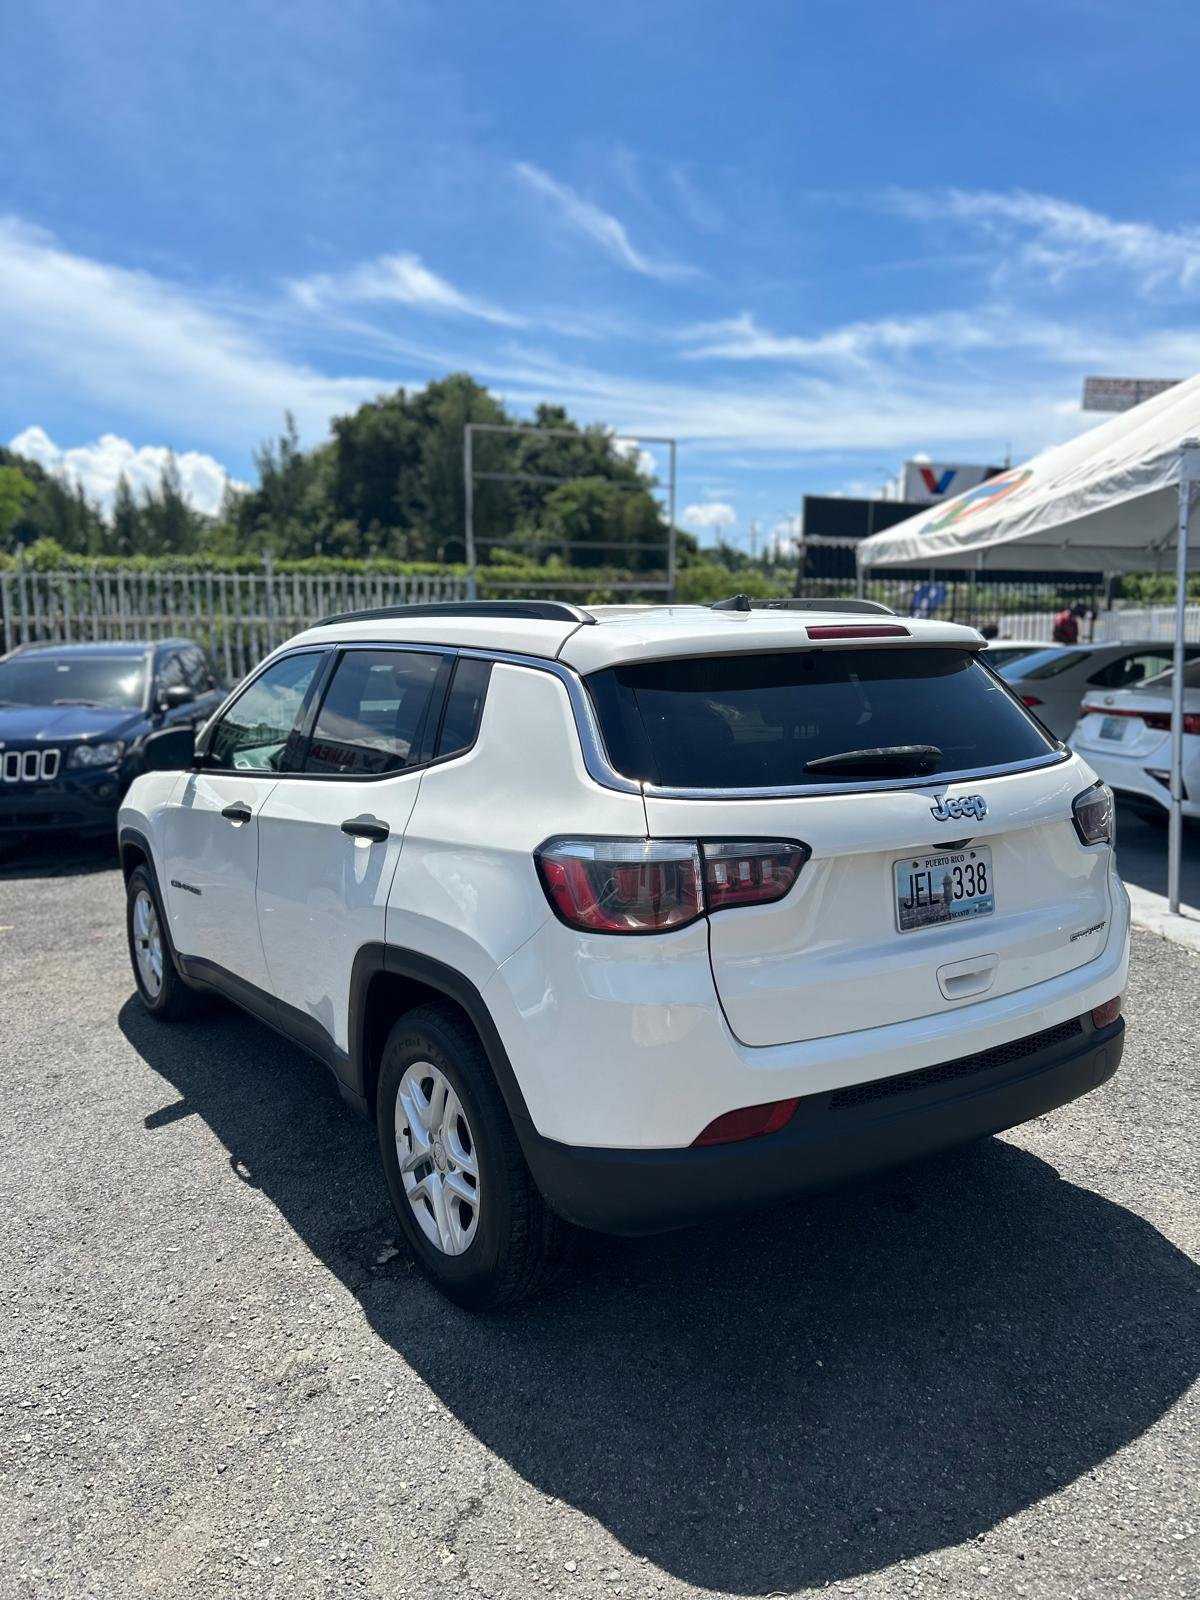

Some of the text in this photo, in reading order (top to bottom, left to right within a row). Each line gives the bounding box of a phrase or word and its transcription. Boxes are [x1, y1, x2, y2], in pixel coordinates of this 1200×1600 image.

[930, 794, 989, 821] Jeep
[925, 854, 965, 868] PUERTO RICO
[903, 862, 988, 910] JEL 338
